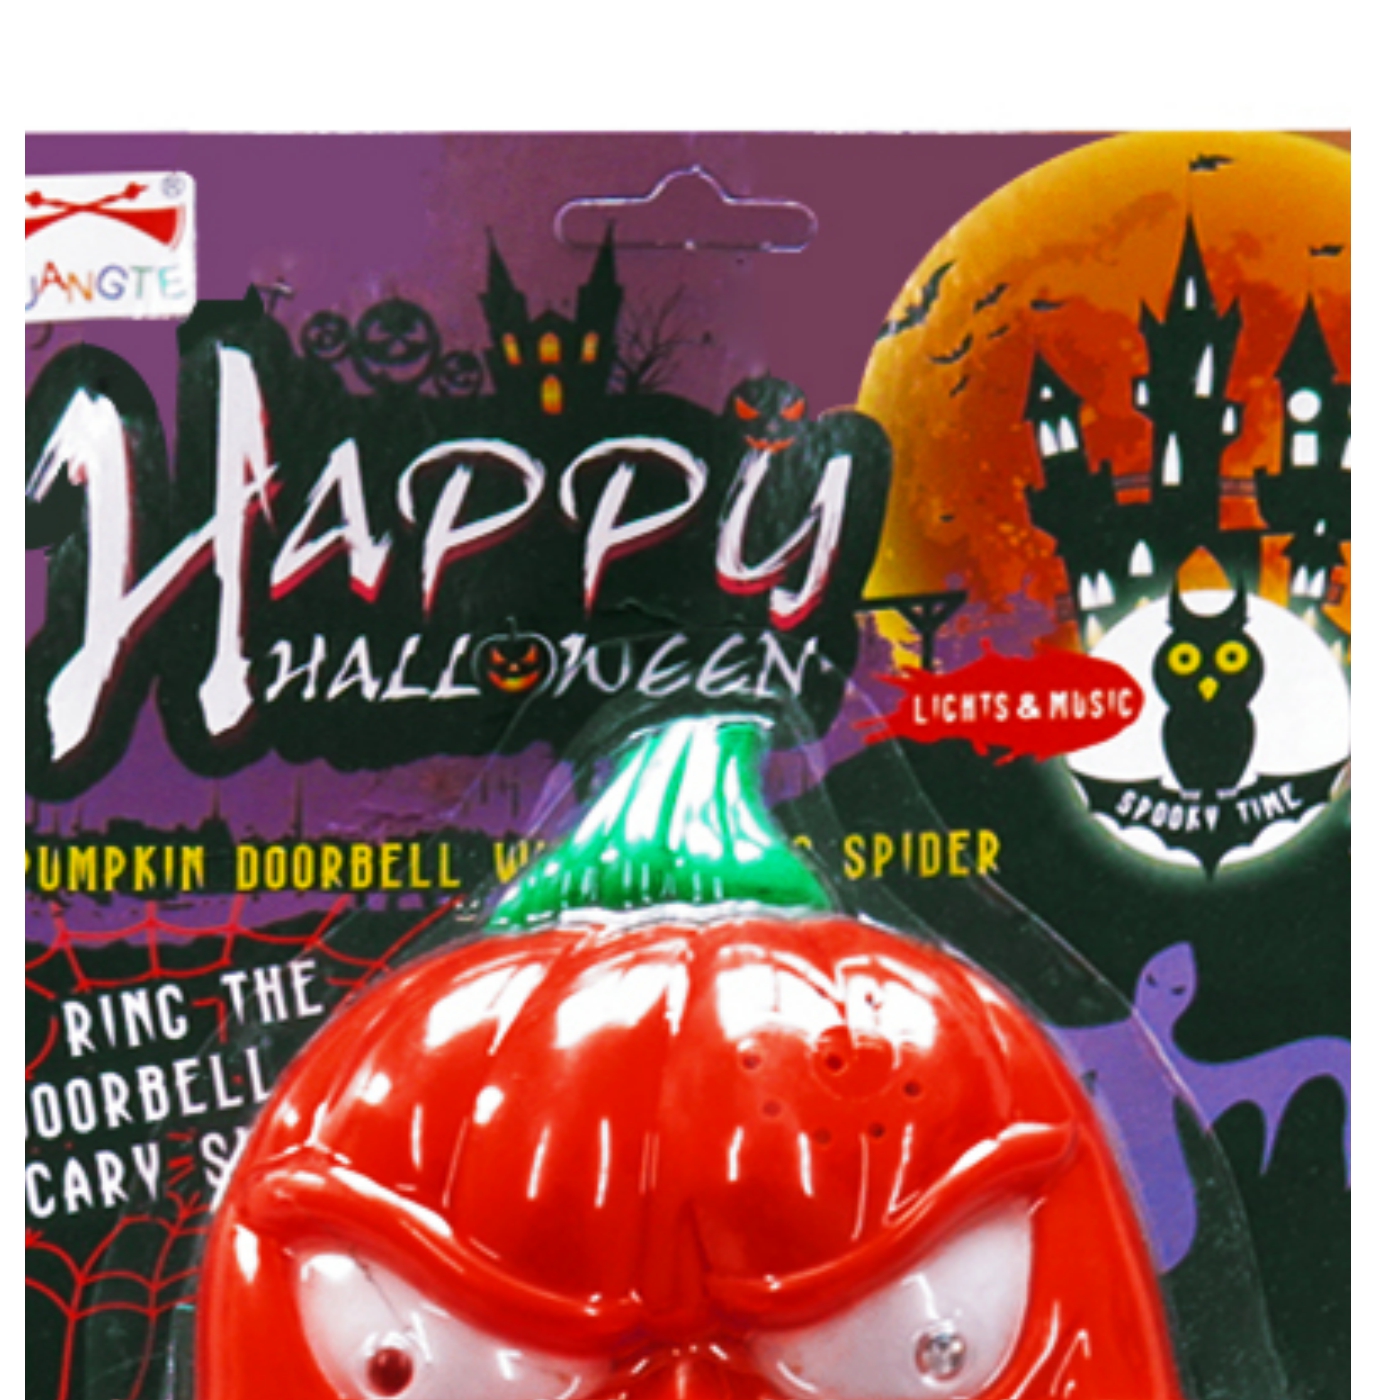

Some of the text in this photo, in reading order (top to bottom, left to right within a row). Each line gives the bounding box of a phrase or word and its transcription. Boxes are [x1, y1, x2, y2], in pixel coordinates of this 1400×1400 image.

[25, 340, 852, 763] HAPPY
[913, 688, 1134, 725] LIGHTS & MUSIC
[1114, 782, 1303, 833] SPOOKY TIME
[236, 842, 461, 891] DOORBELL
[843, 830, 1001, 880] SPIDER
[63, 959, 324, 1058] RING THE
[25, 1045, 273, 1143] OORBELL
